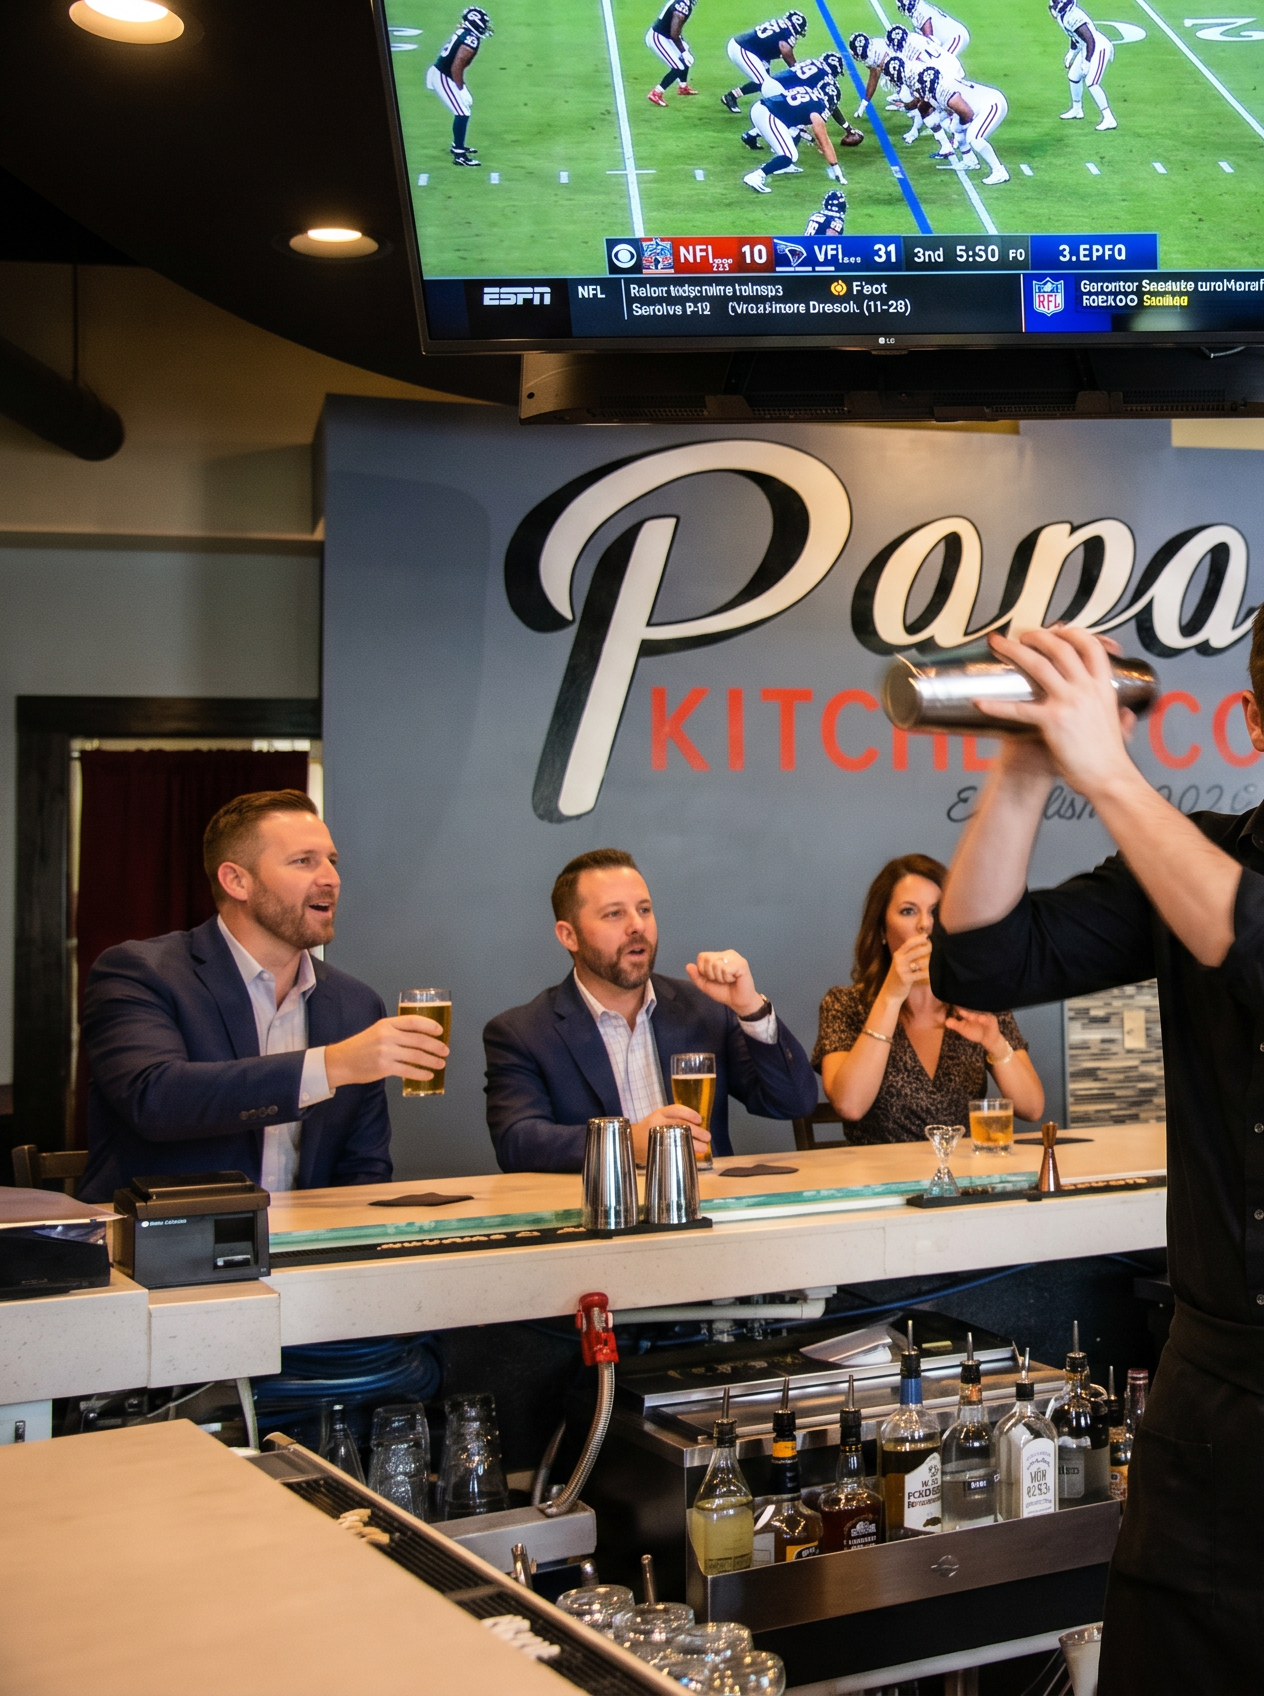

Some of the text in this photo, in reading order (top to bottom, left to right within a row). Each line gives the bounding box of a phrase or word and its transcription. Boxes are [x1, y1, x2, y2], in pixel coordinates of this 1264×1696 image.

[741, 244, 768, 264] 10
[873, 243, 897, 263] 31
[913, 247, 944, 263] 3nd
[955, 244, 1000, 262] 5:50
[483, 286, 552, 306] ESPN
[577, 285, 606, 298] NFL
[863, 298, 911, 316] (11-28)
[649, 686, 1000, 772] KITCH
